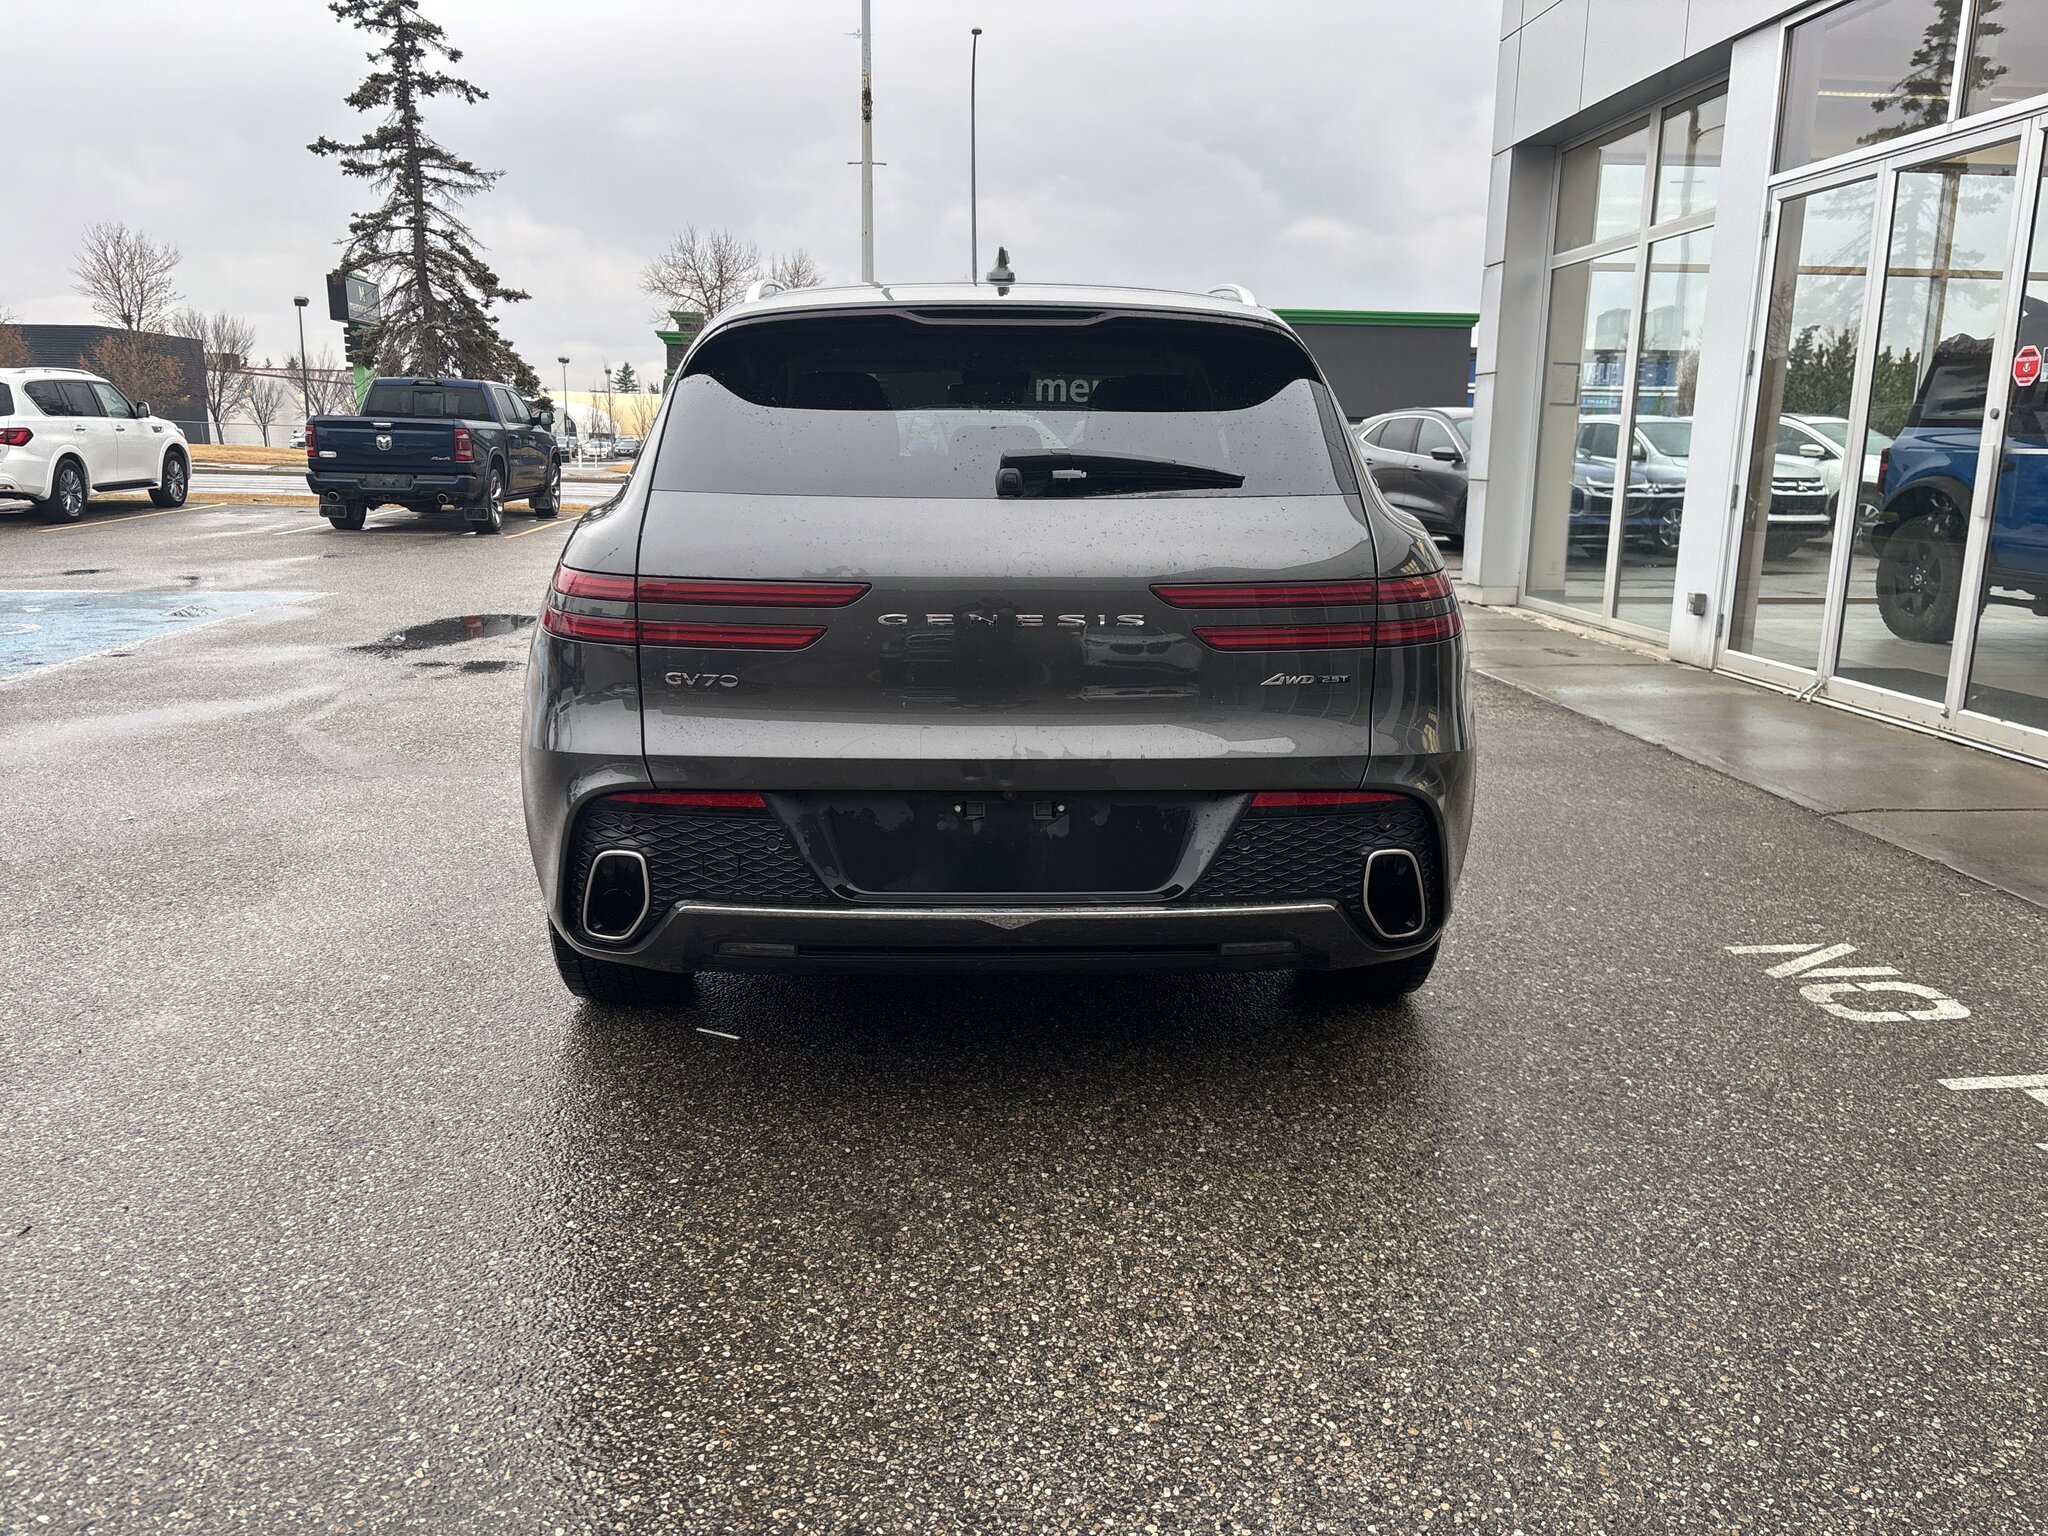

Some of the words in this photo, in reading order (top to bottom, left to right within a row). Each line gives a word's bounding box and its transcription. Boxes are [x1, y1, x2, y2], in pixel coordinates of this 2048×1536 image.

[877, 613, 1145, 627] GENESIS
[664, 671, 739, 687] GV70
[1260, 672, 1315, 686] AWD
[1724, 943, 1972, 1022] NO
